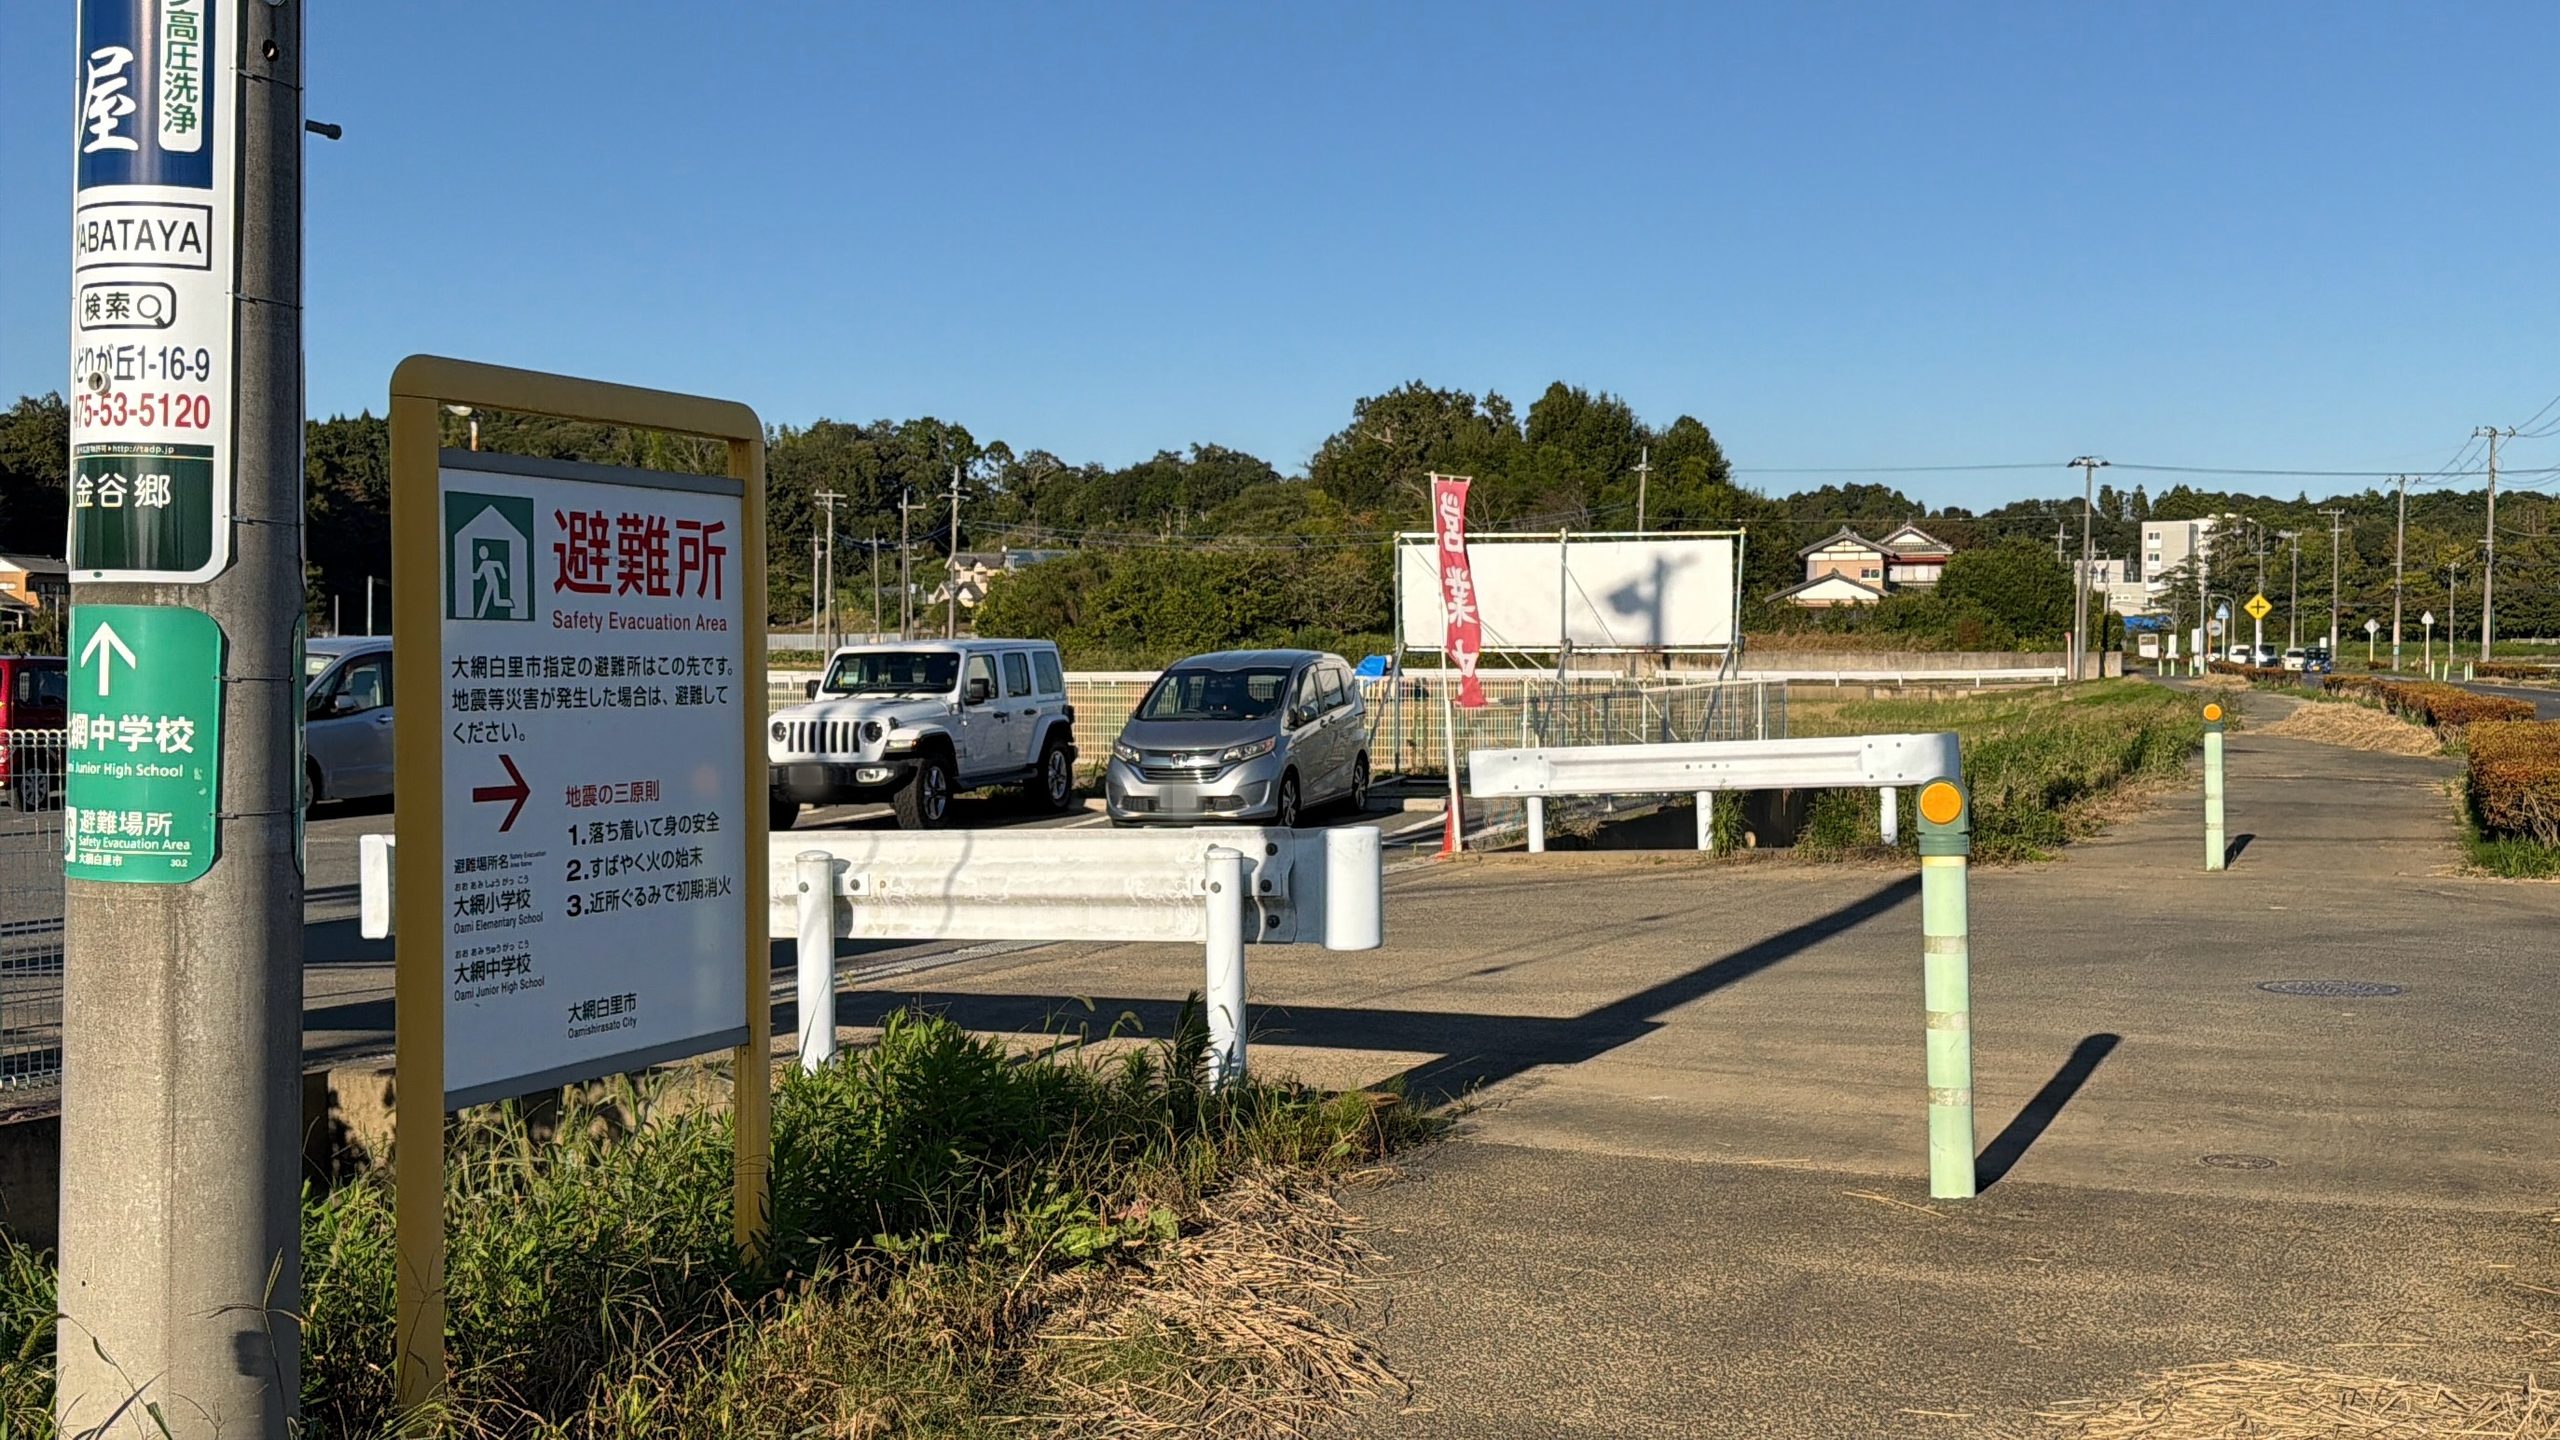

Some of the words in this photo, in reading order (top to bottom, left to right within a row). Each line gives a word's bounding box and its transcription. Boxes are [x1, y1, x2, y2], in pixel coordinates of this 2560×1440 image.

[164, 0, 199, 134] 高圧洗浄
[79, 46, 139, 153] 屋
[77, 219, 202, 256] ABATAYA
[85, 292, 130, 322] 検索
[76, 472, 171, 509] 金谷郷
[553, 508, 727, 600] 避難所
[552, 610, 602, 632] Safety
[609, 611, 690, 631] Evacuation
[696, 613, 727, 631] Area
[451, 655, 733, 679] 大網白里市指定の避難所はこの先です。
[451, 685, 729, 713] 地震等災害が発生した場合は、避難して
[452, 721, 526, 744] ください。
[75, 761, 101, 774] Junior
[104, 762, 132, 778] High
[136, 763, 183, 777] School
[565, 780, 660, 808] 地震の三原則
[79, 809, 173, 837] 避難場所
[79, 835, 101, 850] Safety
[103, 837, 159, 850] Evacuation
[162, 839, 190, 850] Area
[170, 859, 188, 868] 30.2
[454, 854, 509, 874] 避難場所名
[454, 888, 531, 918] 大網小学校
[454, 921, 474, 934] Oami
[476, 917, 517, 931] Elementary
[519, 912, 543, 926] School
[454, 952, 531, 985] 大網中学校
[454, 987, 474, 1001] Oami
[476, 984, 500, 998] Junior
[501, 980, 518, 994] High
[520, 975, 545, 990] School
[568, 992, 637, 1024] 大網白里市
[568, 1020, 621, 1039] Oamishirasato
[623, 1016, 637, 1030] City
